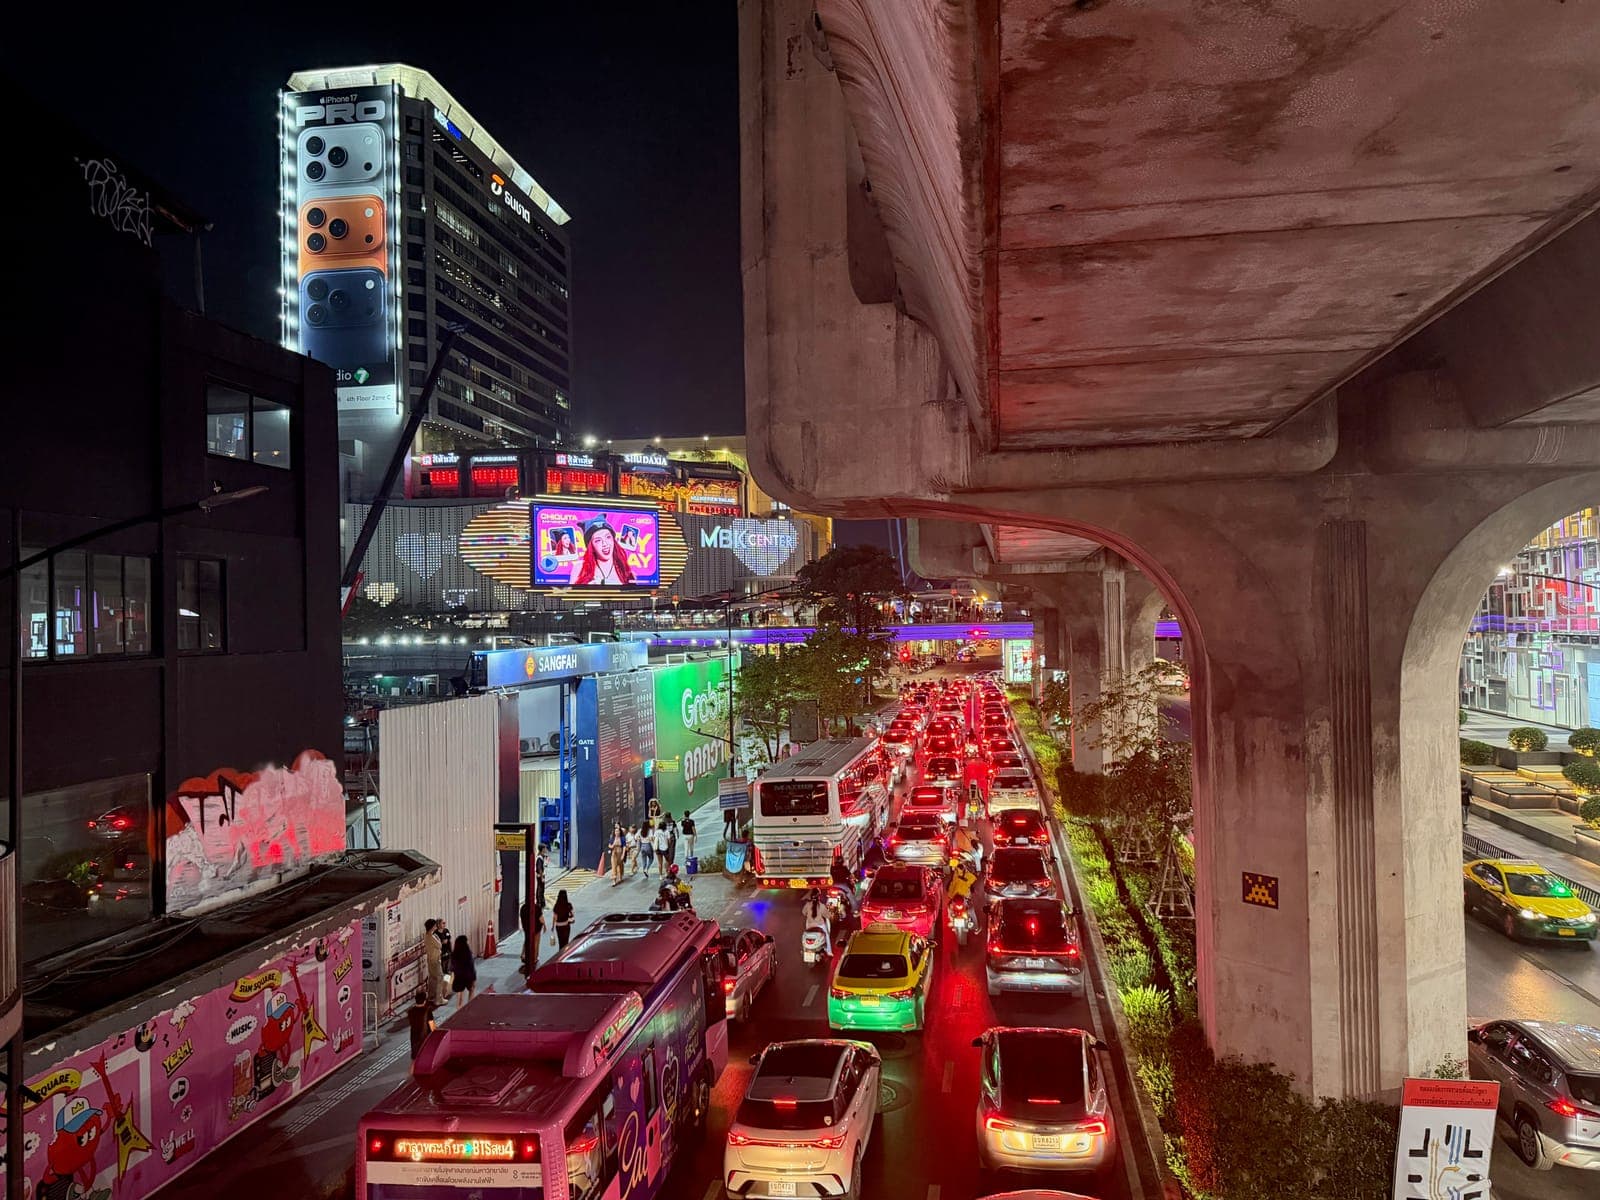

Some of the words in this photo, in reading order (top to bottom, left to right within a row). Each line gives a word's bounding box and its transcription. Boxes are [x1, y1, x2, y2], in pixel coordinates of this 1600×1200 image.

[325, 96, 350, 104] iPhone
[350, 94, 358, 102] 17
[295, 100, 386, 127] PRO
[700, 525, 748, 549] MBK
[748, 534, 793, 548] CENTER
[538, 653, 578, 673] SANGFAH
[583, 746, 589, 761] 1
[333, 953, 353, 981] YEAH!
[239, 983, 253, 993] SIAM
[231, 1020, 253, 1039] MUSIC
[162, 1037, 194, 1073] YEAH!
